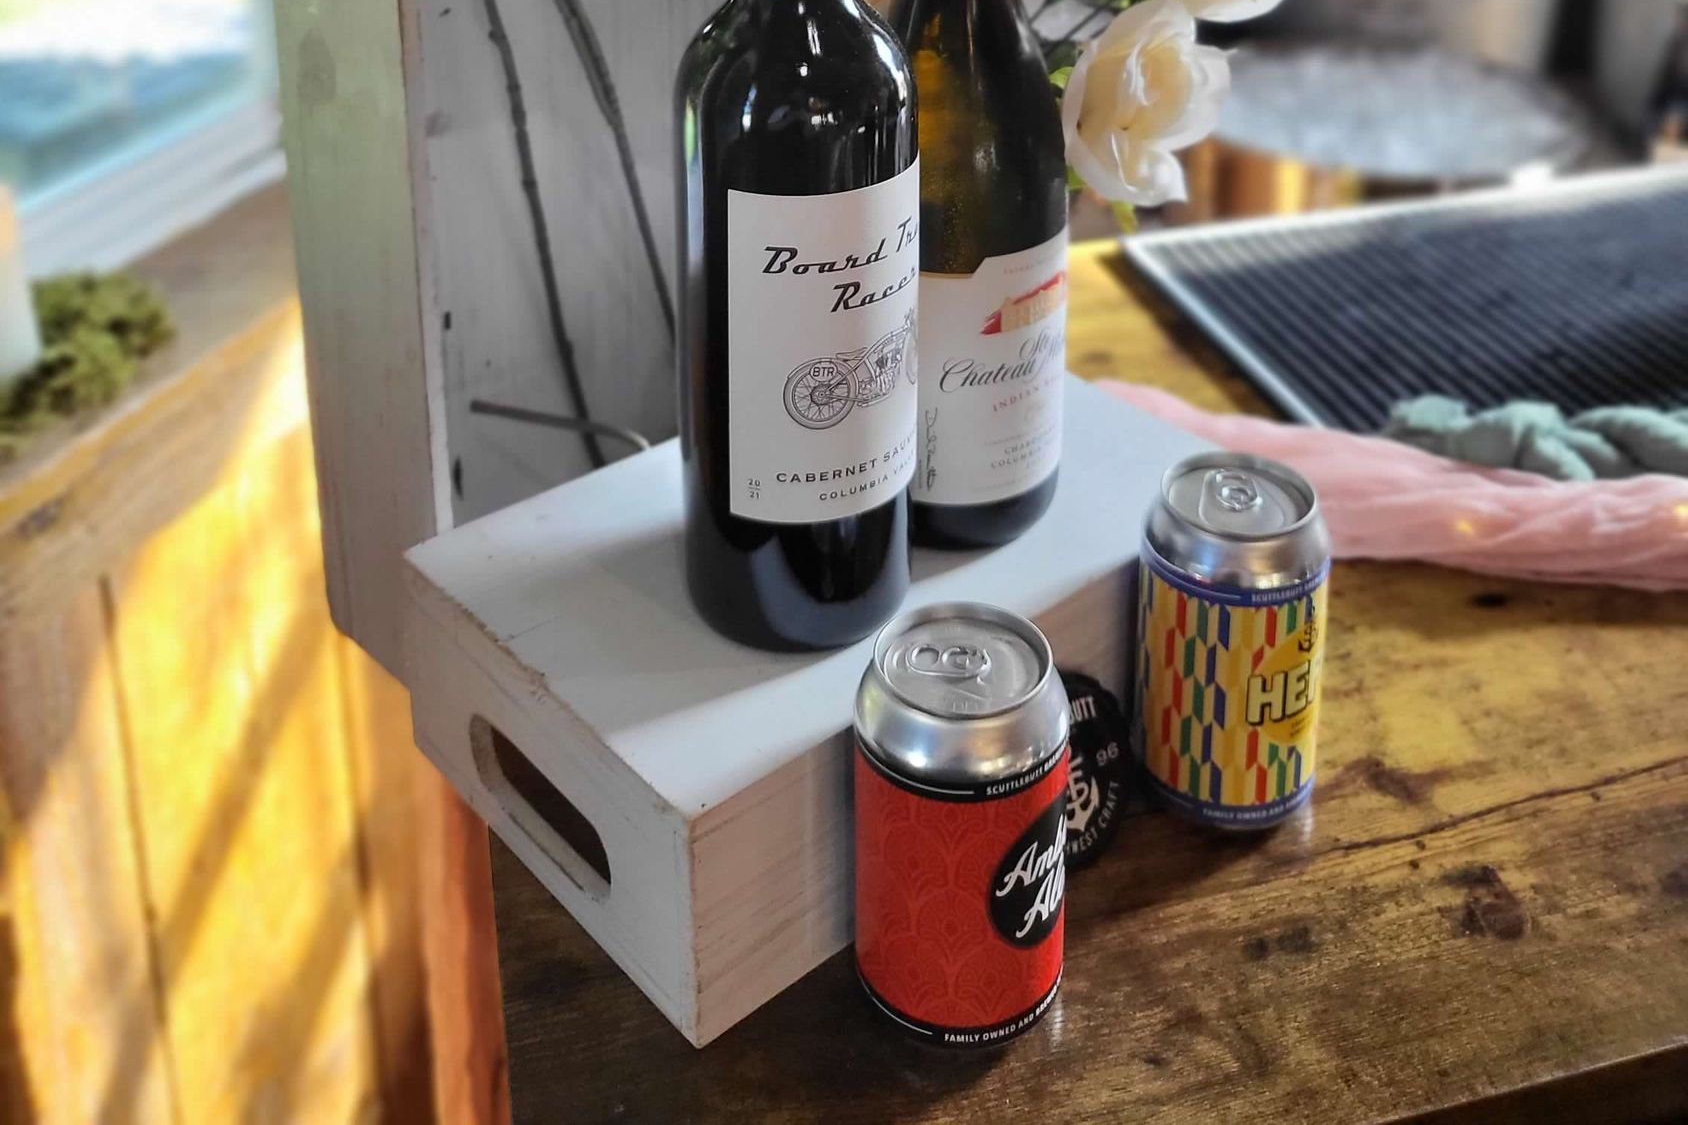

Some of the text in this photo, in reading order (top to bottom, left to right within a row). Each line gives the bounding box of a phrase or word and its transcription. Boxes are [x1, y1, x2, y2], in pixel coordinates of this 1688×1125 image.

[762, 215, 919, 275] Board Tr
[812, 366, 835, 377] BTR
[939, 358, 1037, 393] Chateau
[747, 477, 761, 487] 20
[776, 457, 878, 483] CABERNET
[749, 490, 760, 500] 21
[819, 474, 889, 501] COLUMBIA
[1096, 741, 1119, 767] 96
[986, 765, 1043, 795] SCUTTLEBUTT
[1097, 780, 1121, 828] CRAFT
[944, 1033, 980, 1044] FAMILY
[982, 1023, 1016, 1042] OWNED
[1018, 1012, 1035, 1030] AND
